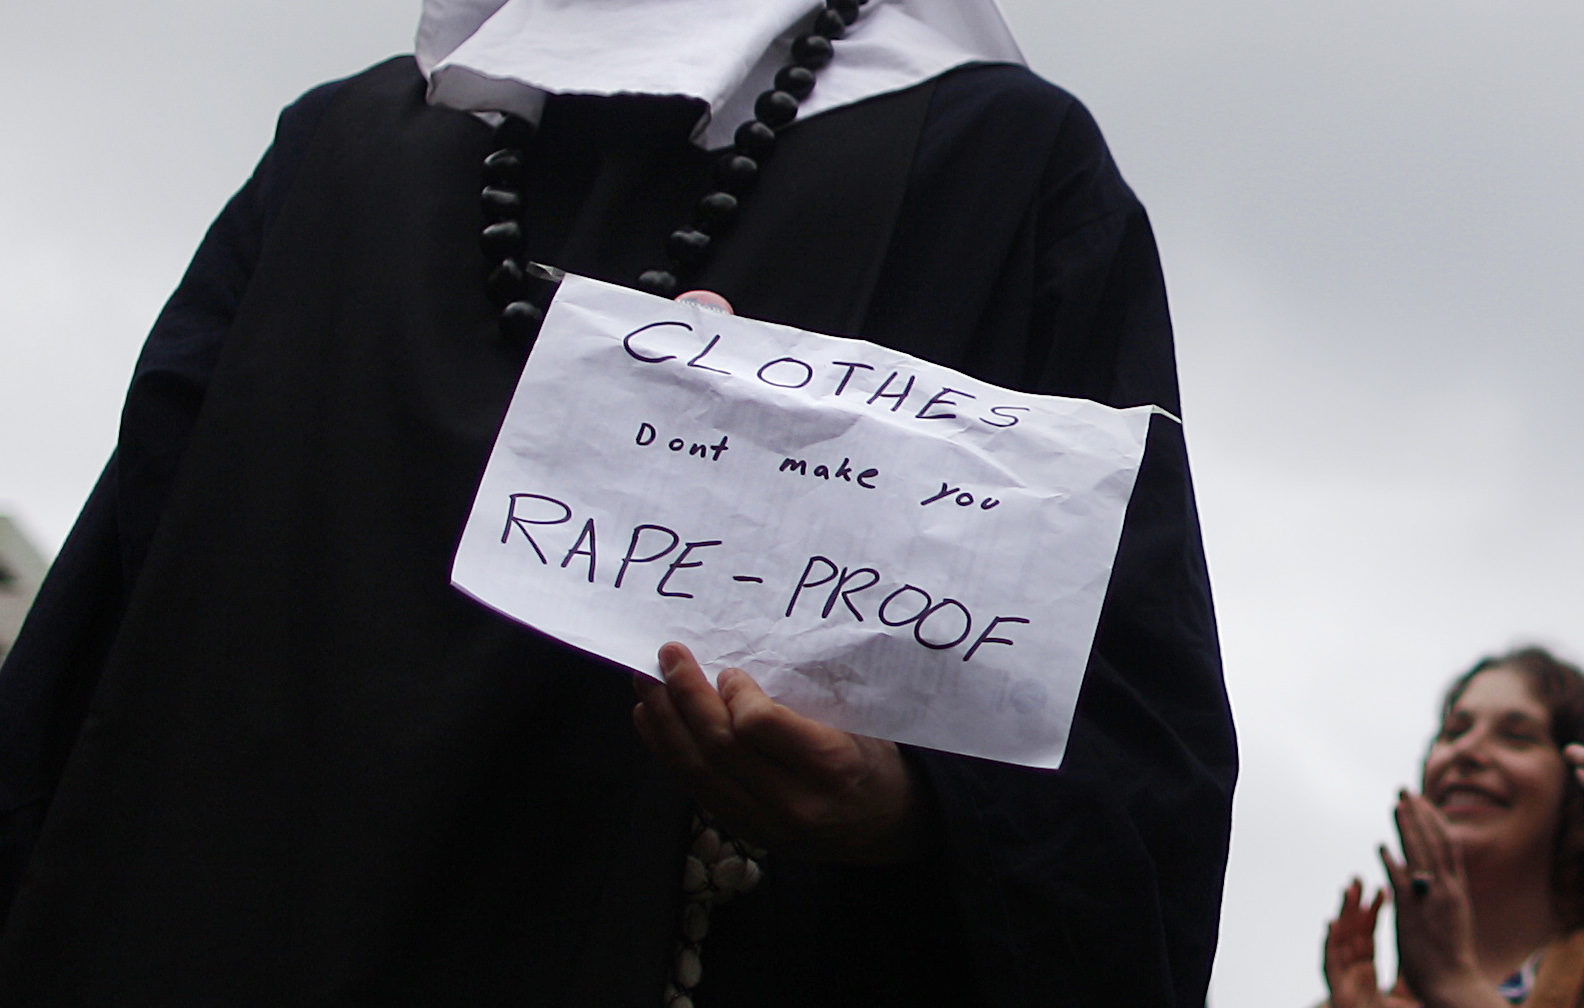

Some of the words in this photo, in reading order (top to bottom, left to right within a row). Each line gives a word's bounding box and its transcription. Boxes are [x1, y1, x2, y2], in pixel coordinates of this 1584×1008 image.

[622, 321, 1030, 429] CLOTHES
[634, 421, 730, 461] Dont
[778, 457, 879, 491] make
[921, 482, 1000, 511] you
